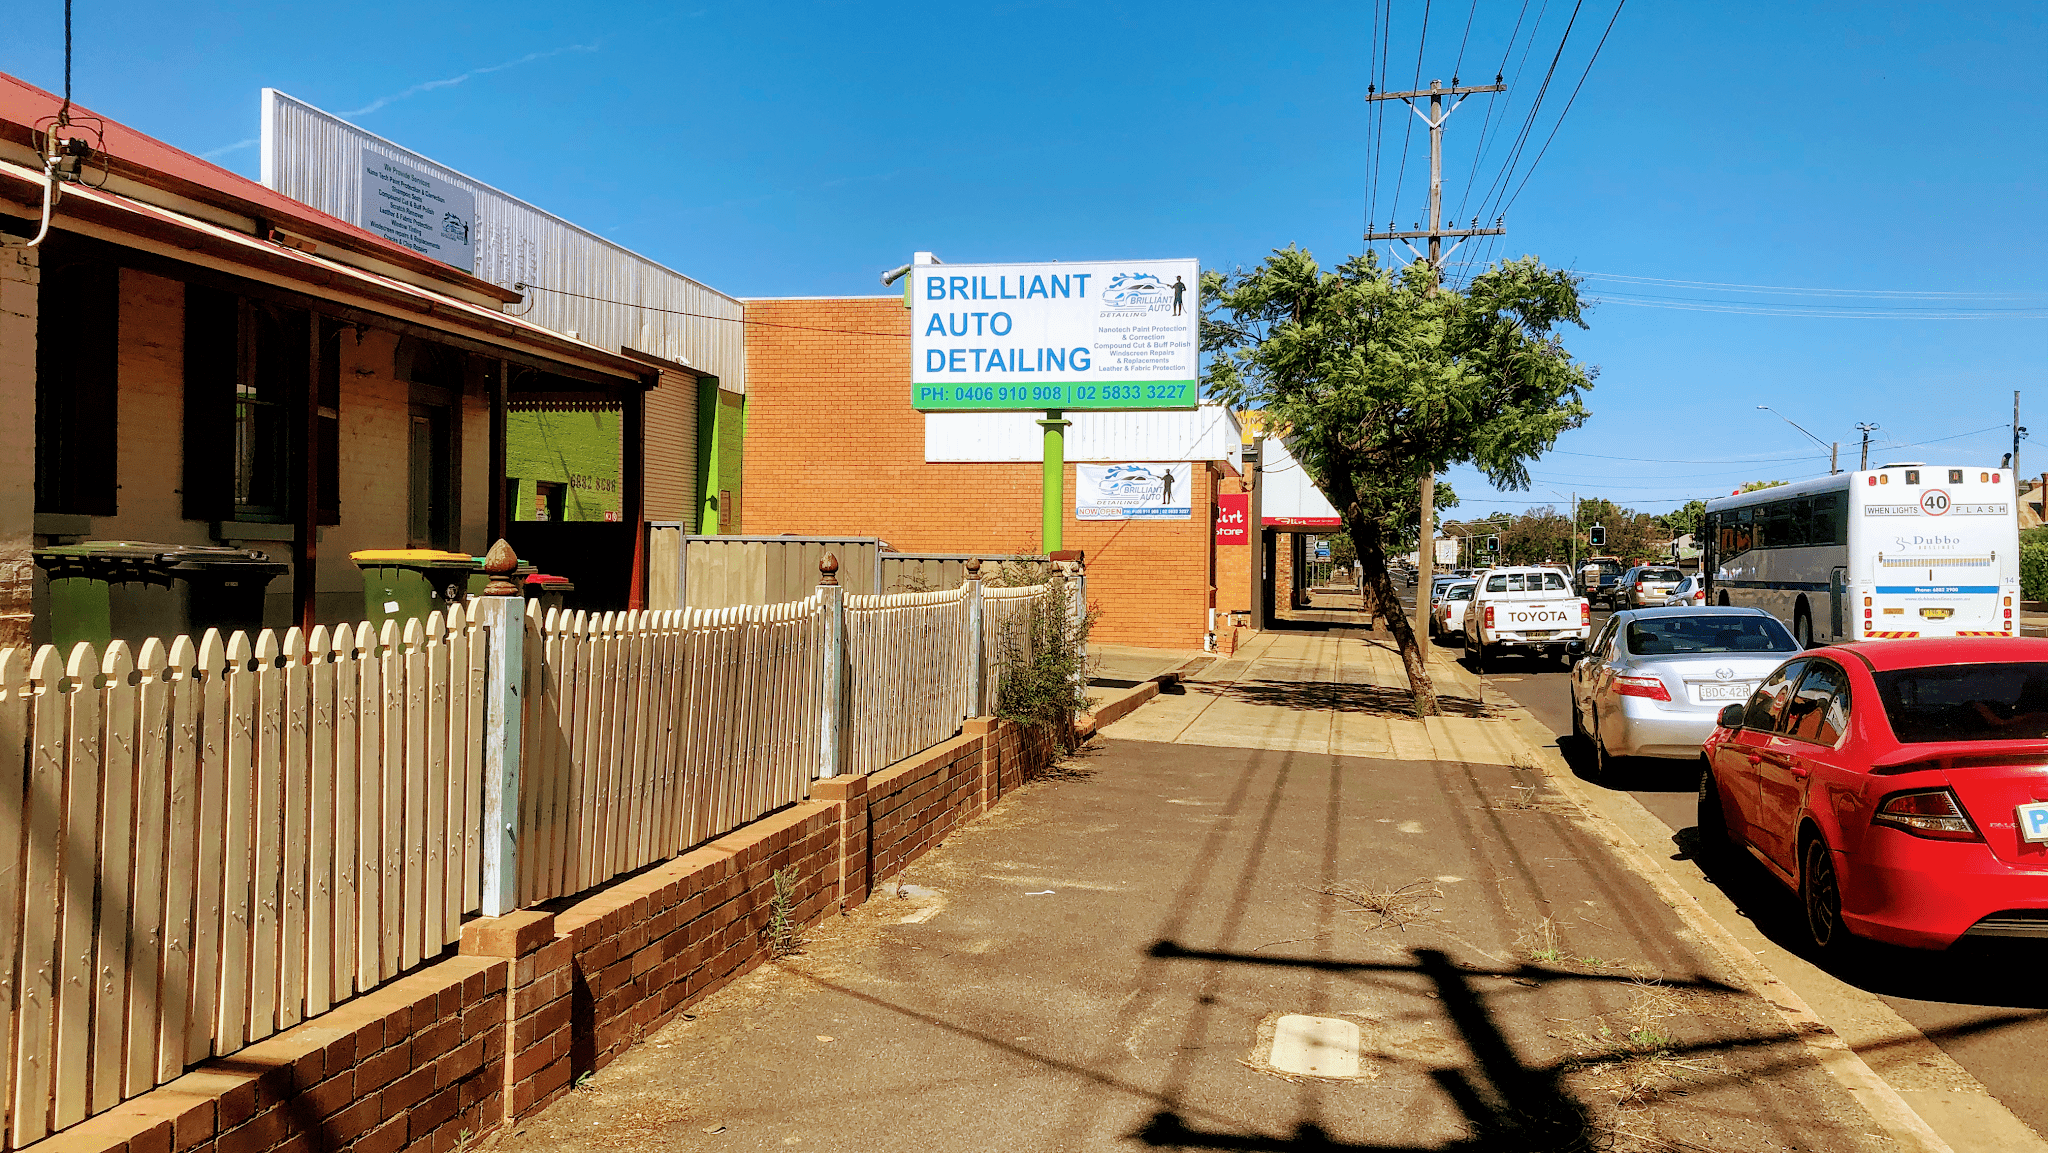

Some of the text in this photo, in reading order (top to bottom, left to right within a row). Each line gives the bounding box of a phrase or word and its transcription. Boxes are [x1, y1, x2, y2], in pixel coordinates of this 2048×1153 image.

[393, 167, 410, 179] Provide
[412, 174, 430, 188] Services
[926, 274, 1092, 300] BRILLIANT
[1130, 296, 1173, 304] BRILLIANT
[925, 312, 1012, 337] AUTO
[926, 346, 1091, 373] DETAILING
[922, 387, 948, 401] PH:
[955, 387, 993, 401] 0406
[998, 386, 1027, 400] 910
[1032, 386, 1061, 400] 908
[1076, 386, 1096, 400] 02
[1102, 386, 1141, 399] 5833
[1147, 385, 1186, 399] 3227
[1924, 496, 1947, 509] 40
[1914, 535, 1960, 545] Dubbo
[1508, 611, 1568, 622] TOYOTA
